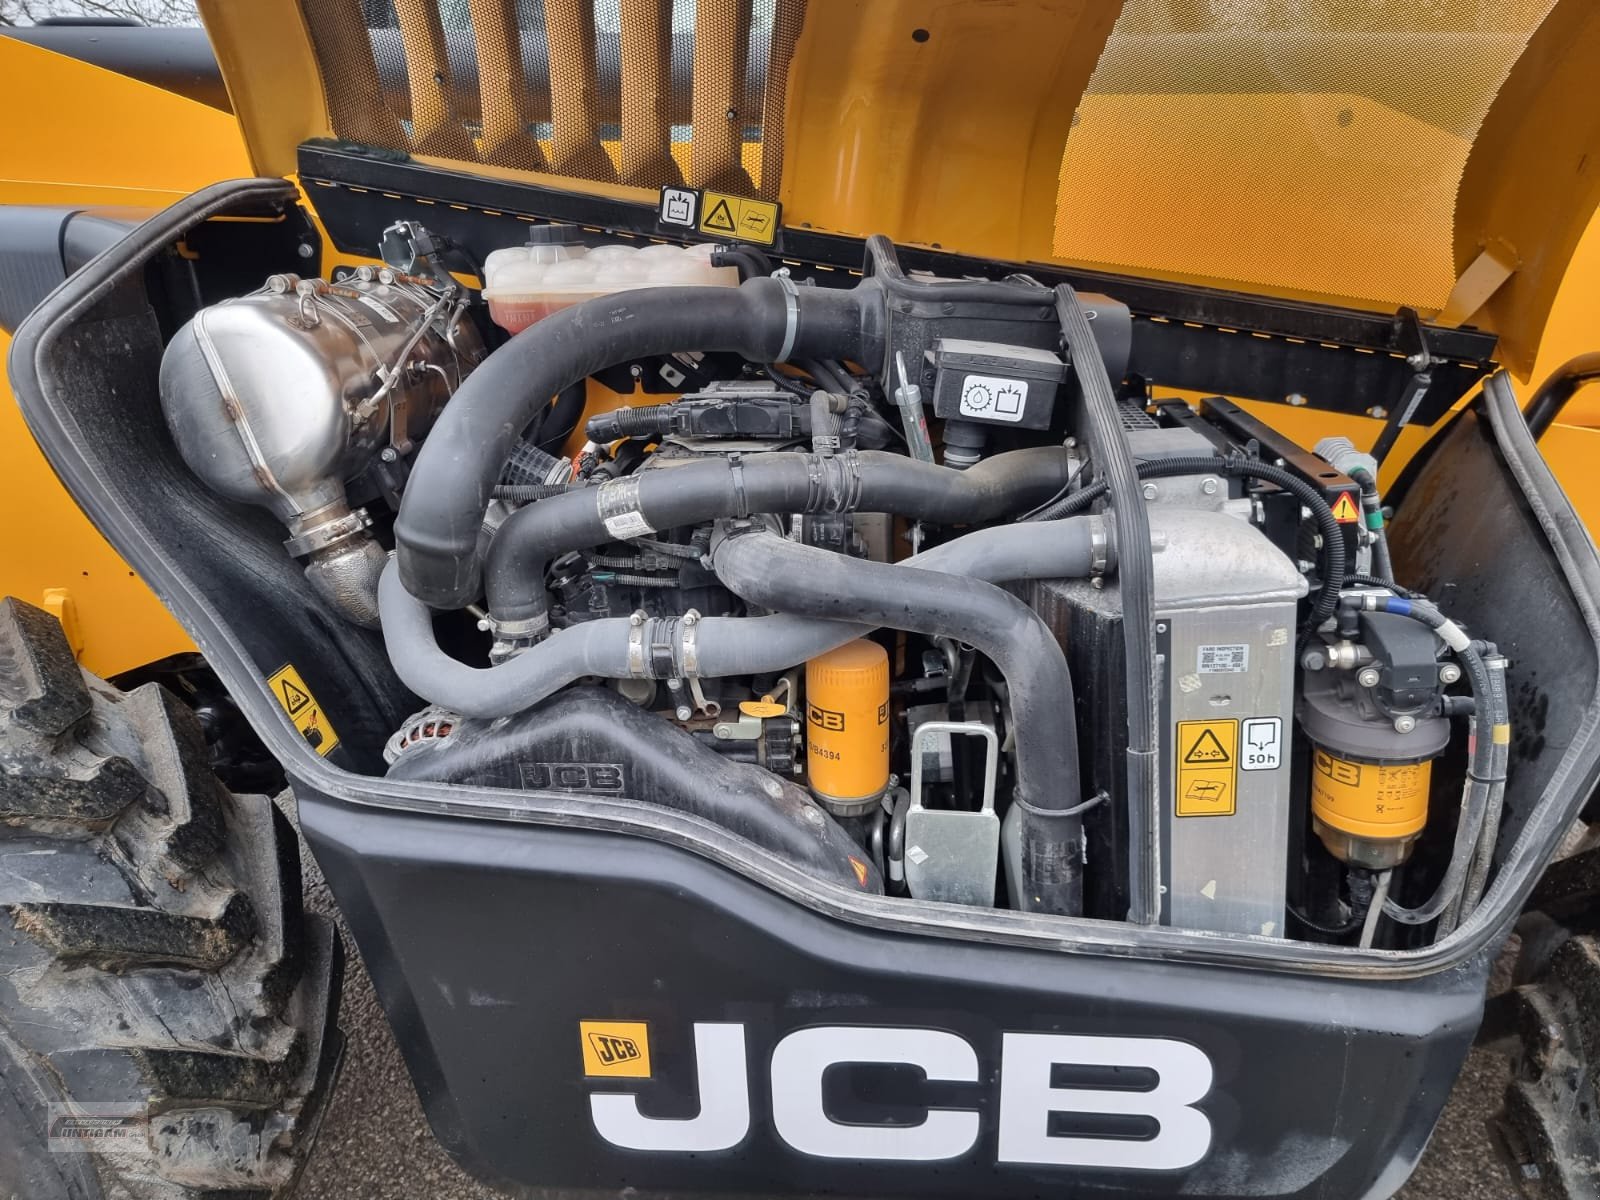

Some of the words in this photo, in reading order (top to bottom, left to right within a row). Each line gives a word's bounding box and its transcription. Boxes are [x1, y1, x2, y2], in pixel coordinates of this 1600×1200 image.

[808, 702, 843, 732] CB
[521, 763, 624, 790] JCB
[1315, 752, 1359, 787] CB
[597, 1036, 638, 1062] JCB
[589, 1021, 1214, 1170] JCB
